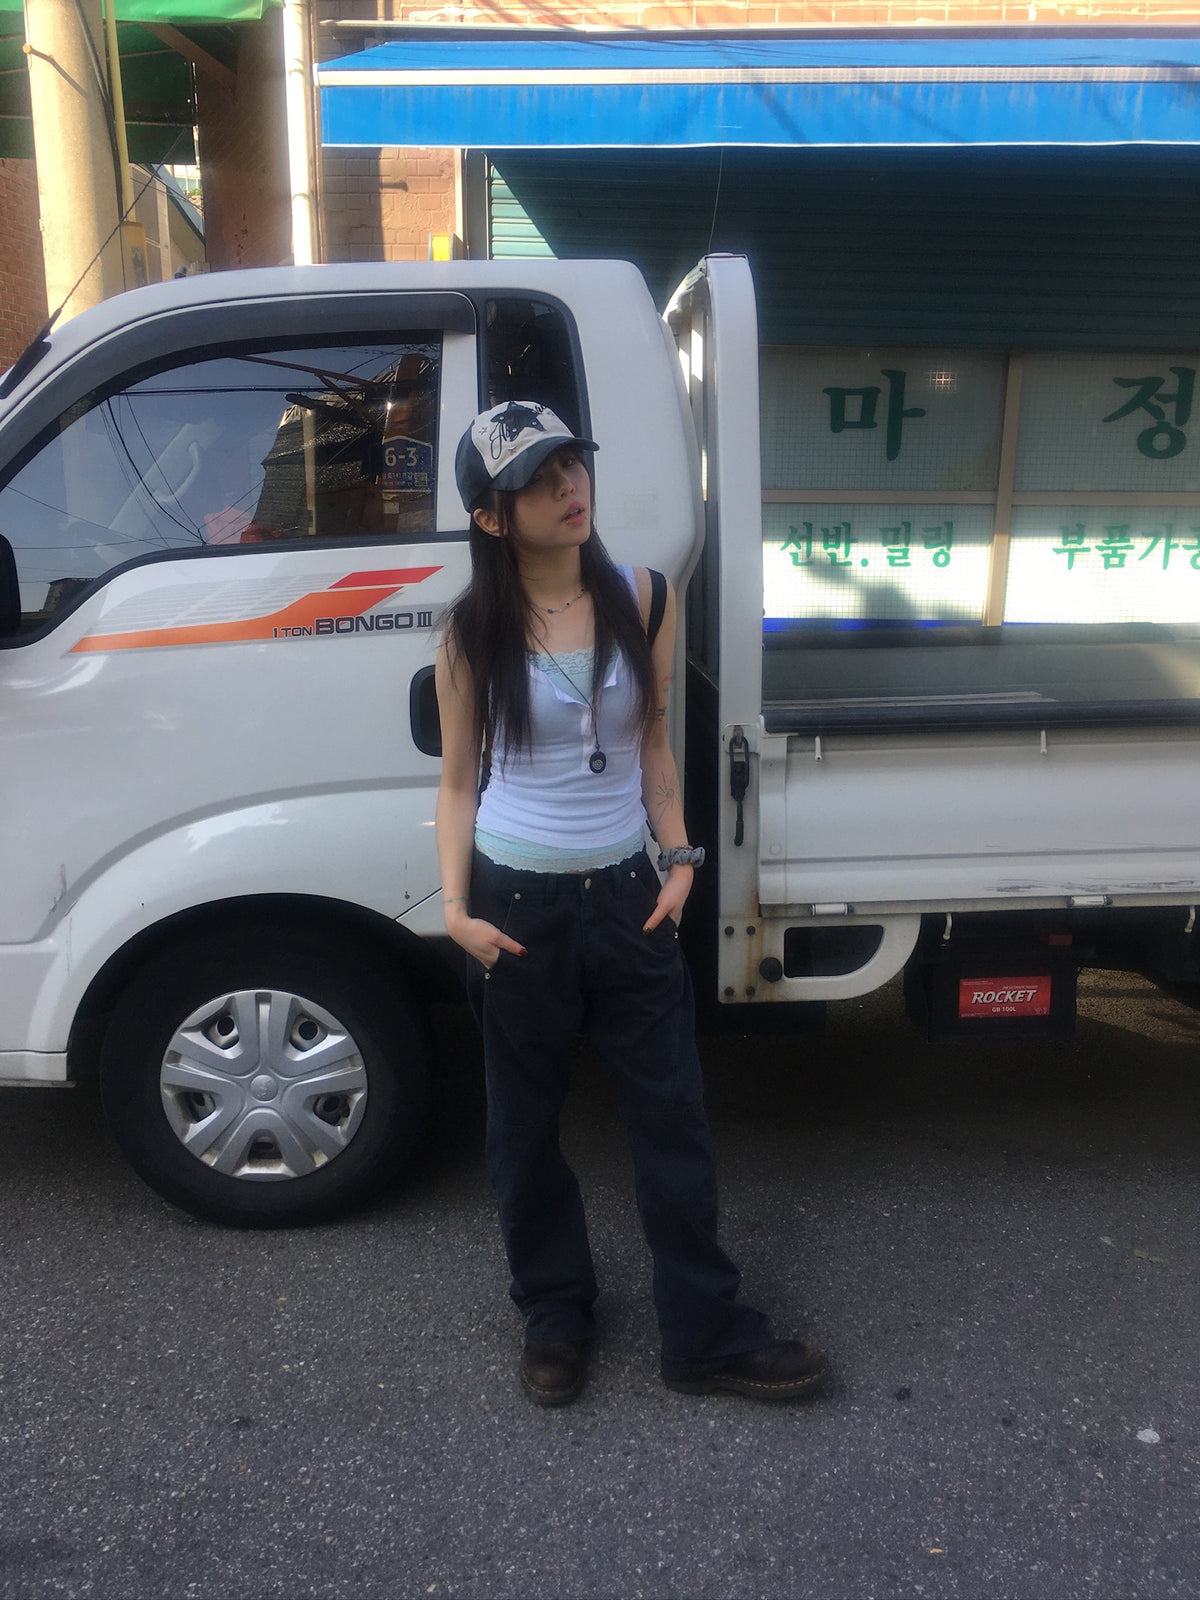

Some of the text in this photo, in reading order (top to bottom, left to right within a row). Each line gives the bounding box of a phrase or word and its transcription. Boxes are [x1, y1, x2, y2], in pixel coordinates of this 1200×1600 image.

[822, 366, 1196, 461] 마 정
[384, 447, 418, 467] 6-3
[281, 626, 313, 637] TON
[315, 612, 414, 636] BONGO
[971, 989, 1037, 1004] ROCKET
